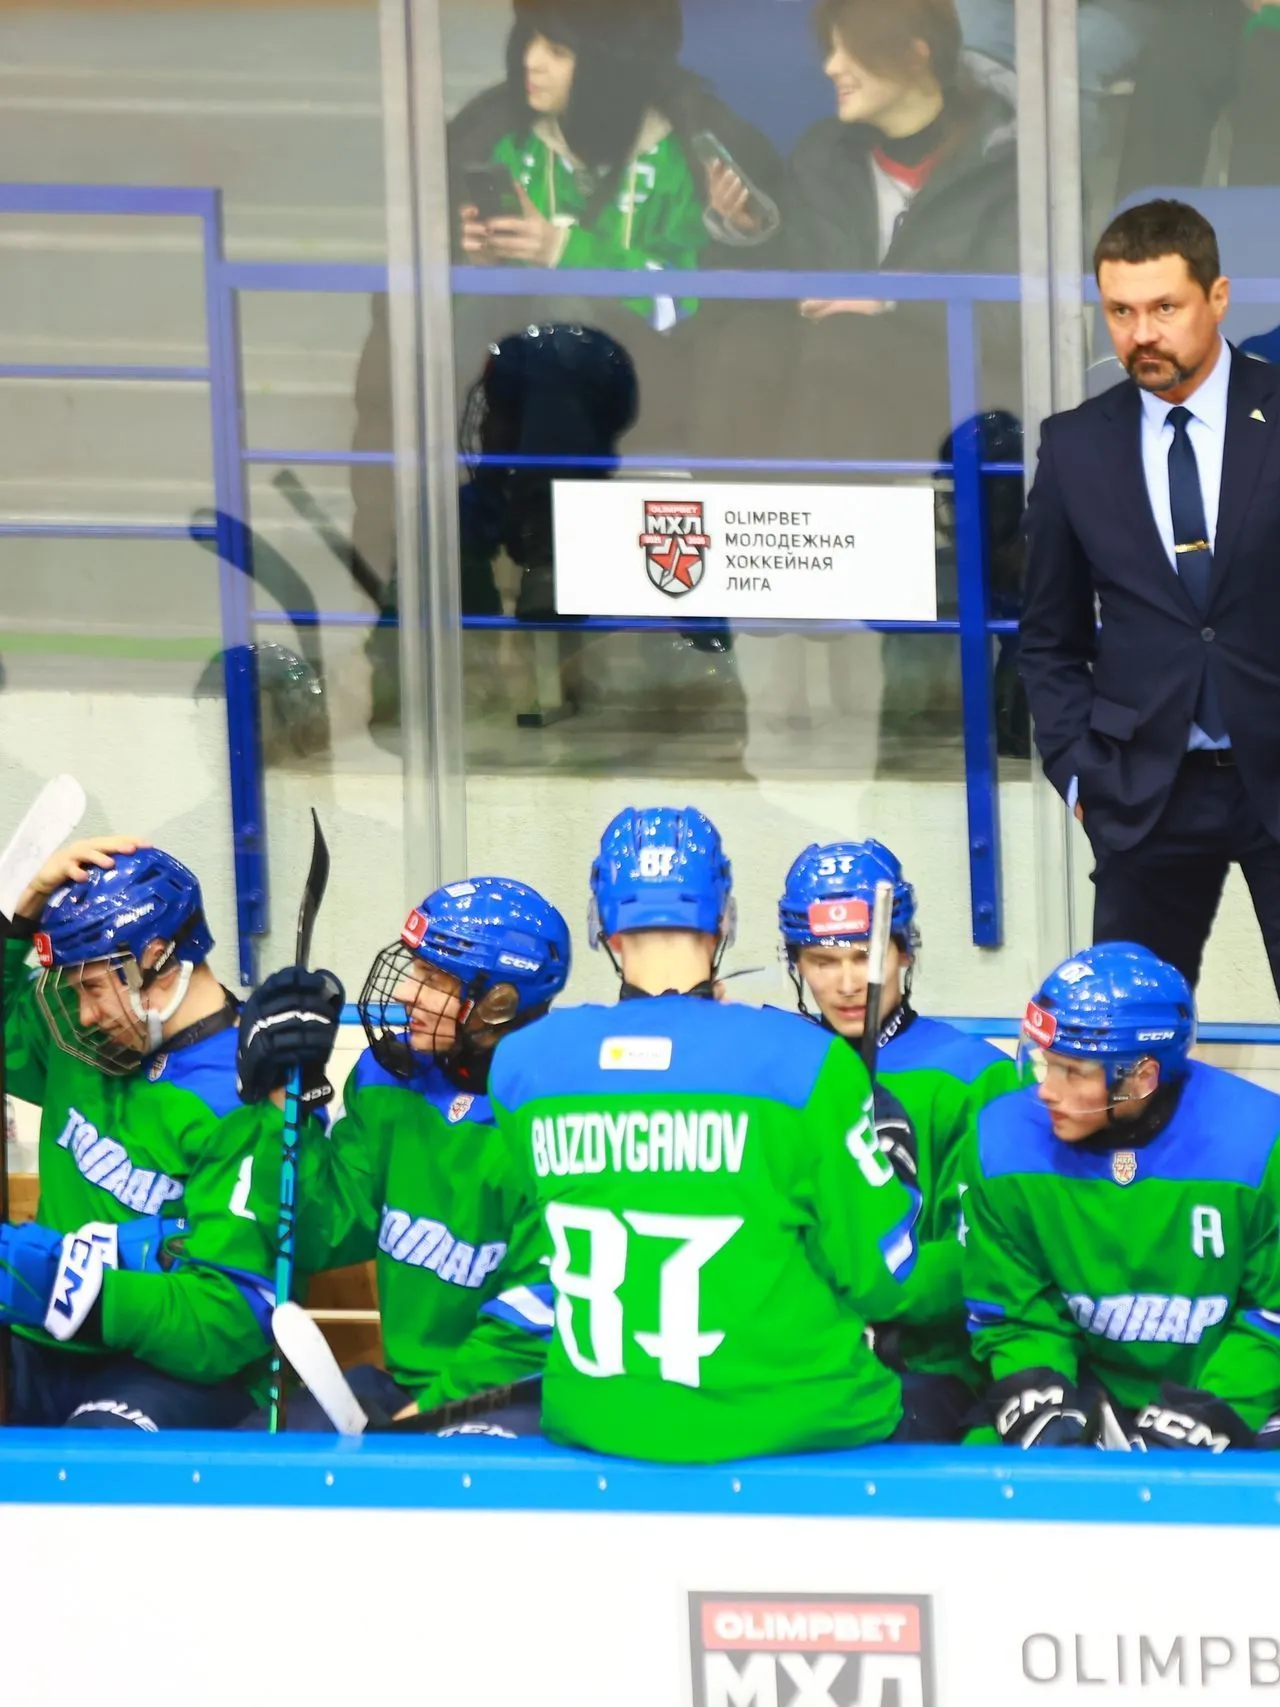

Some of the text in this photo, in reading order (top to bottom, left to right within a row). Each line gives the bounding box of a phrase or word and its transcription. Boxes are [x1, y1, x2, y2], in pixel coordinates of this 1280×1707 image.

[647, 515, 703, 535] МХЛ
[724, 510, 812, 526] OLIMPBET
[725, 532, 855, 550] МОЛОДЕЖНАЯ
[725, 551, 834, 570] ХОККЕЙНАЯ
[726, 576, 772, 591] ЛИГА
[1137, 1030, 1175, 1042] CCM
[531, 1109, 750, 1178] BUZDYGANOV
[1193, 1205, 1225, 1258] A
[545, 1201, 745, 1388] 87
[714, 1611, 908, 1645] OLIMPBET
